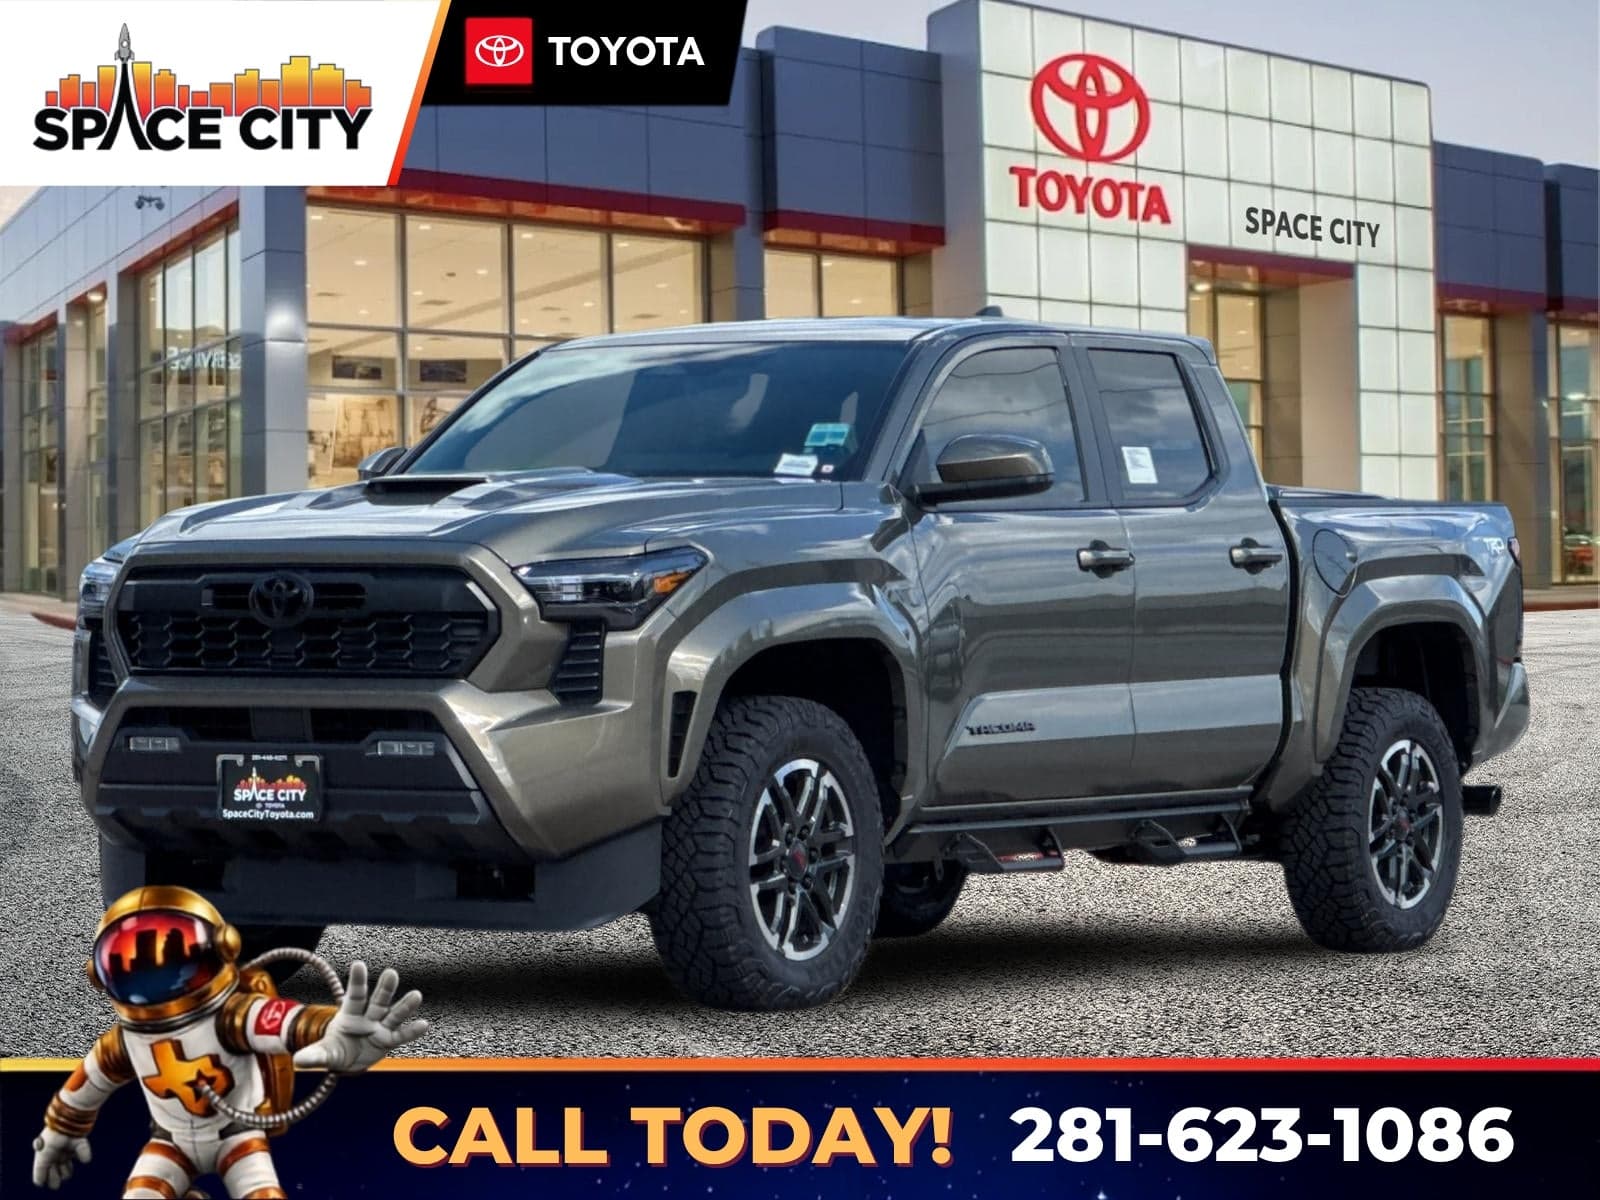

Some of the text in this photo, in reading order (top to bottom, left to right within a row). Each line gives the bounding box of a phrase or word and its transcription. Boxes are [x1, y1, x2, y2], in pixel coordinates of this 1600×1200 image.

[1010, 165, 1171, 224] TOYOTA
[1245, 206, 1381, 248] SPACE CITY
[233, 788, 307, 802] SPACE CITY
[222, 808, 315, 820] SpaceCityToyota.com
